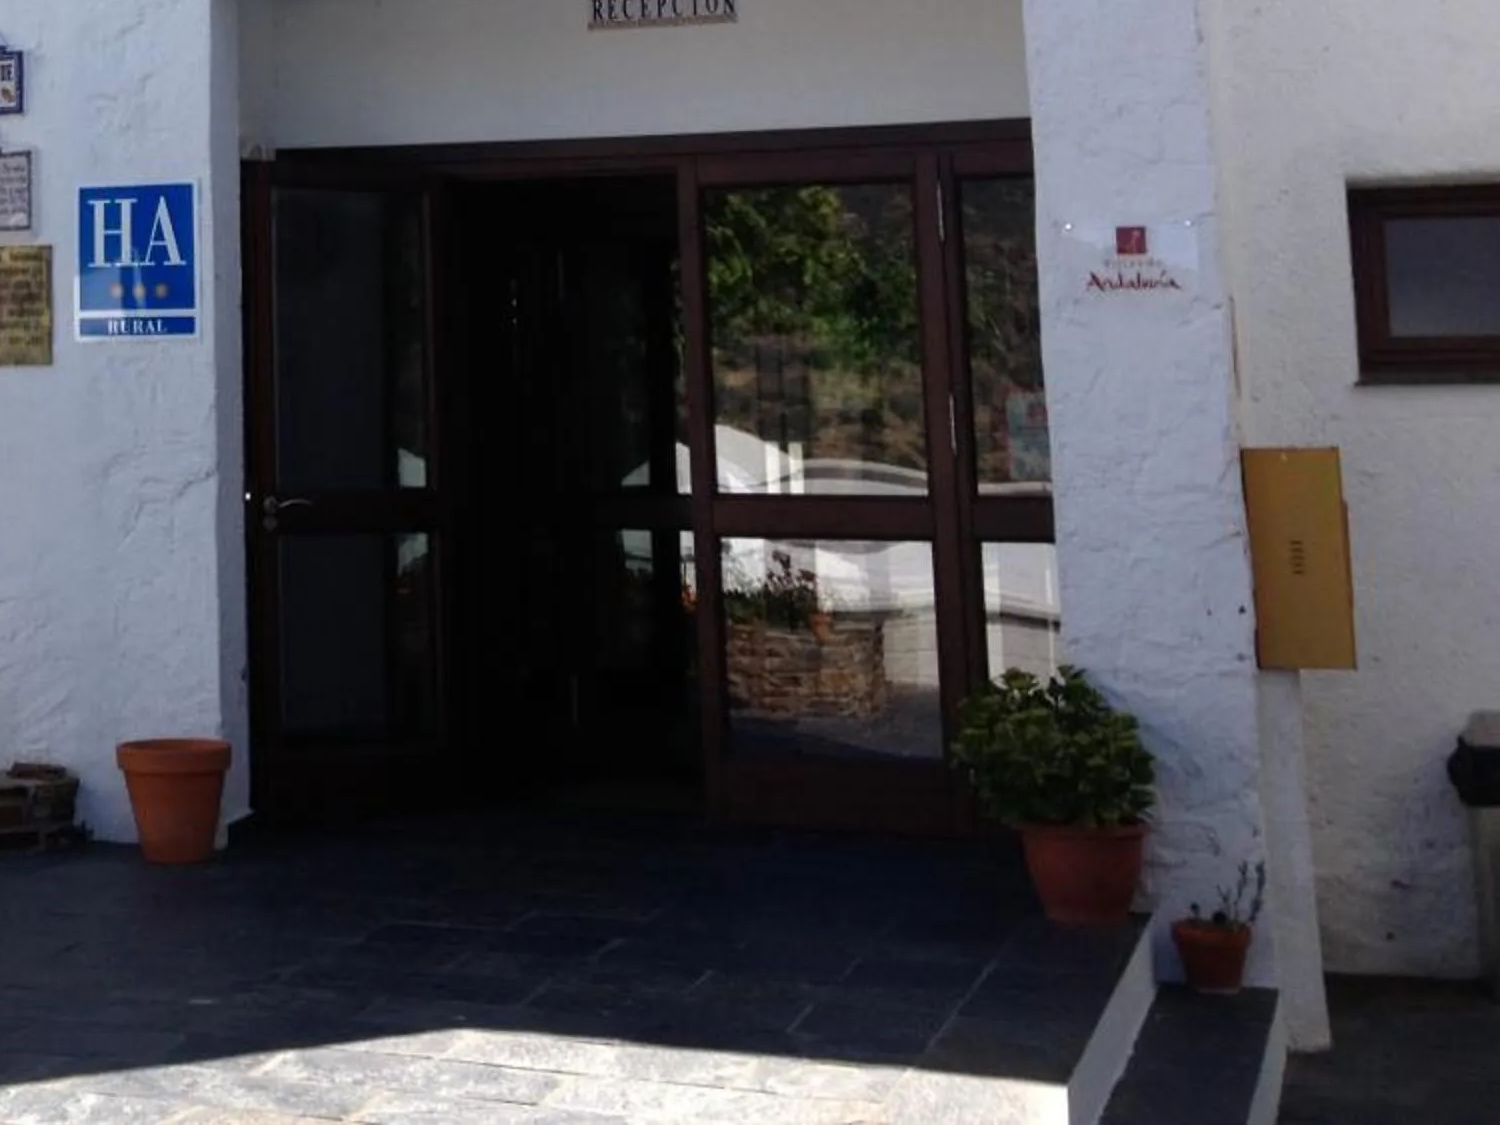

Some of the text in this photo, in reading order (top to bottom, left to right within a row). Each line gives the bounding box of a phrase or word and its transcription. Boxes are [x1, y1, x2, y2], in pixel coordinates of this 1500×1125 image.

[1, 64, 13, 81] DE
[88, 195, 187, 268] HA
[108, 319, 168, 335] RURAL
